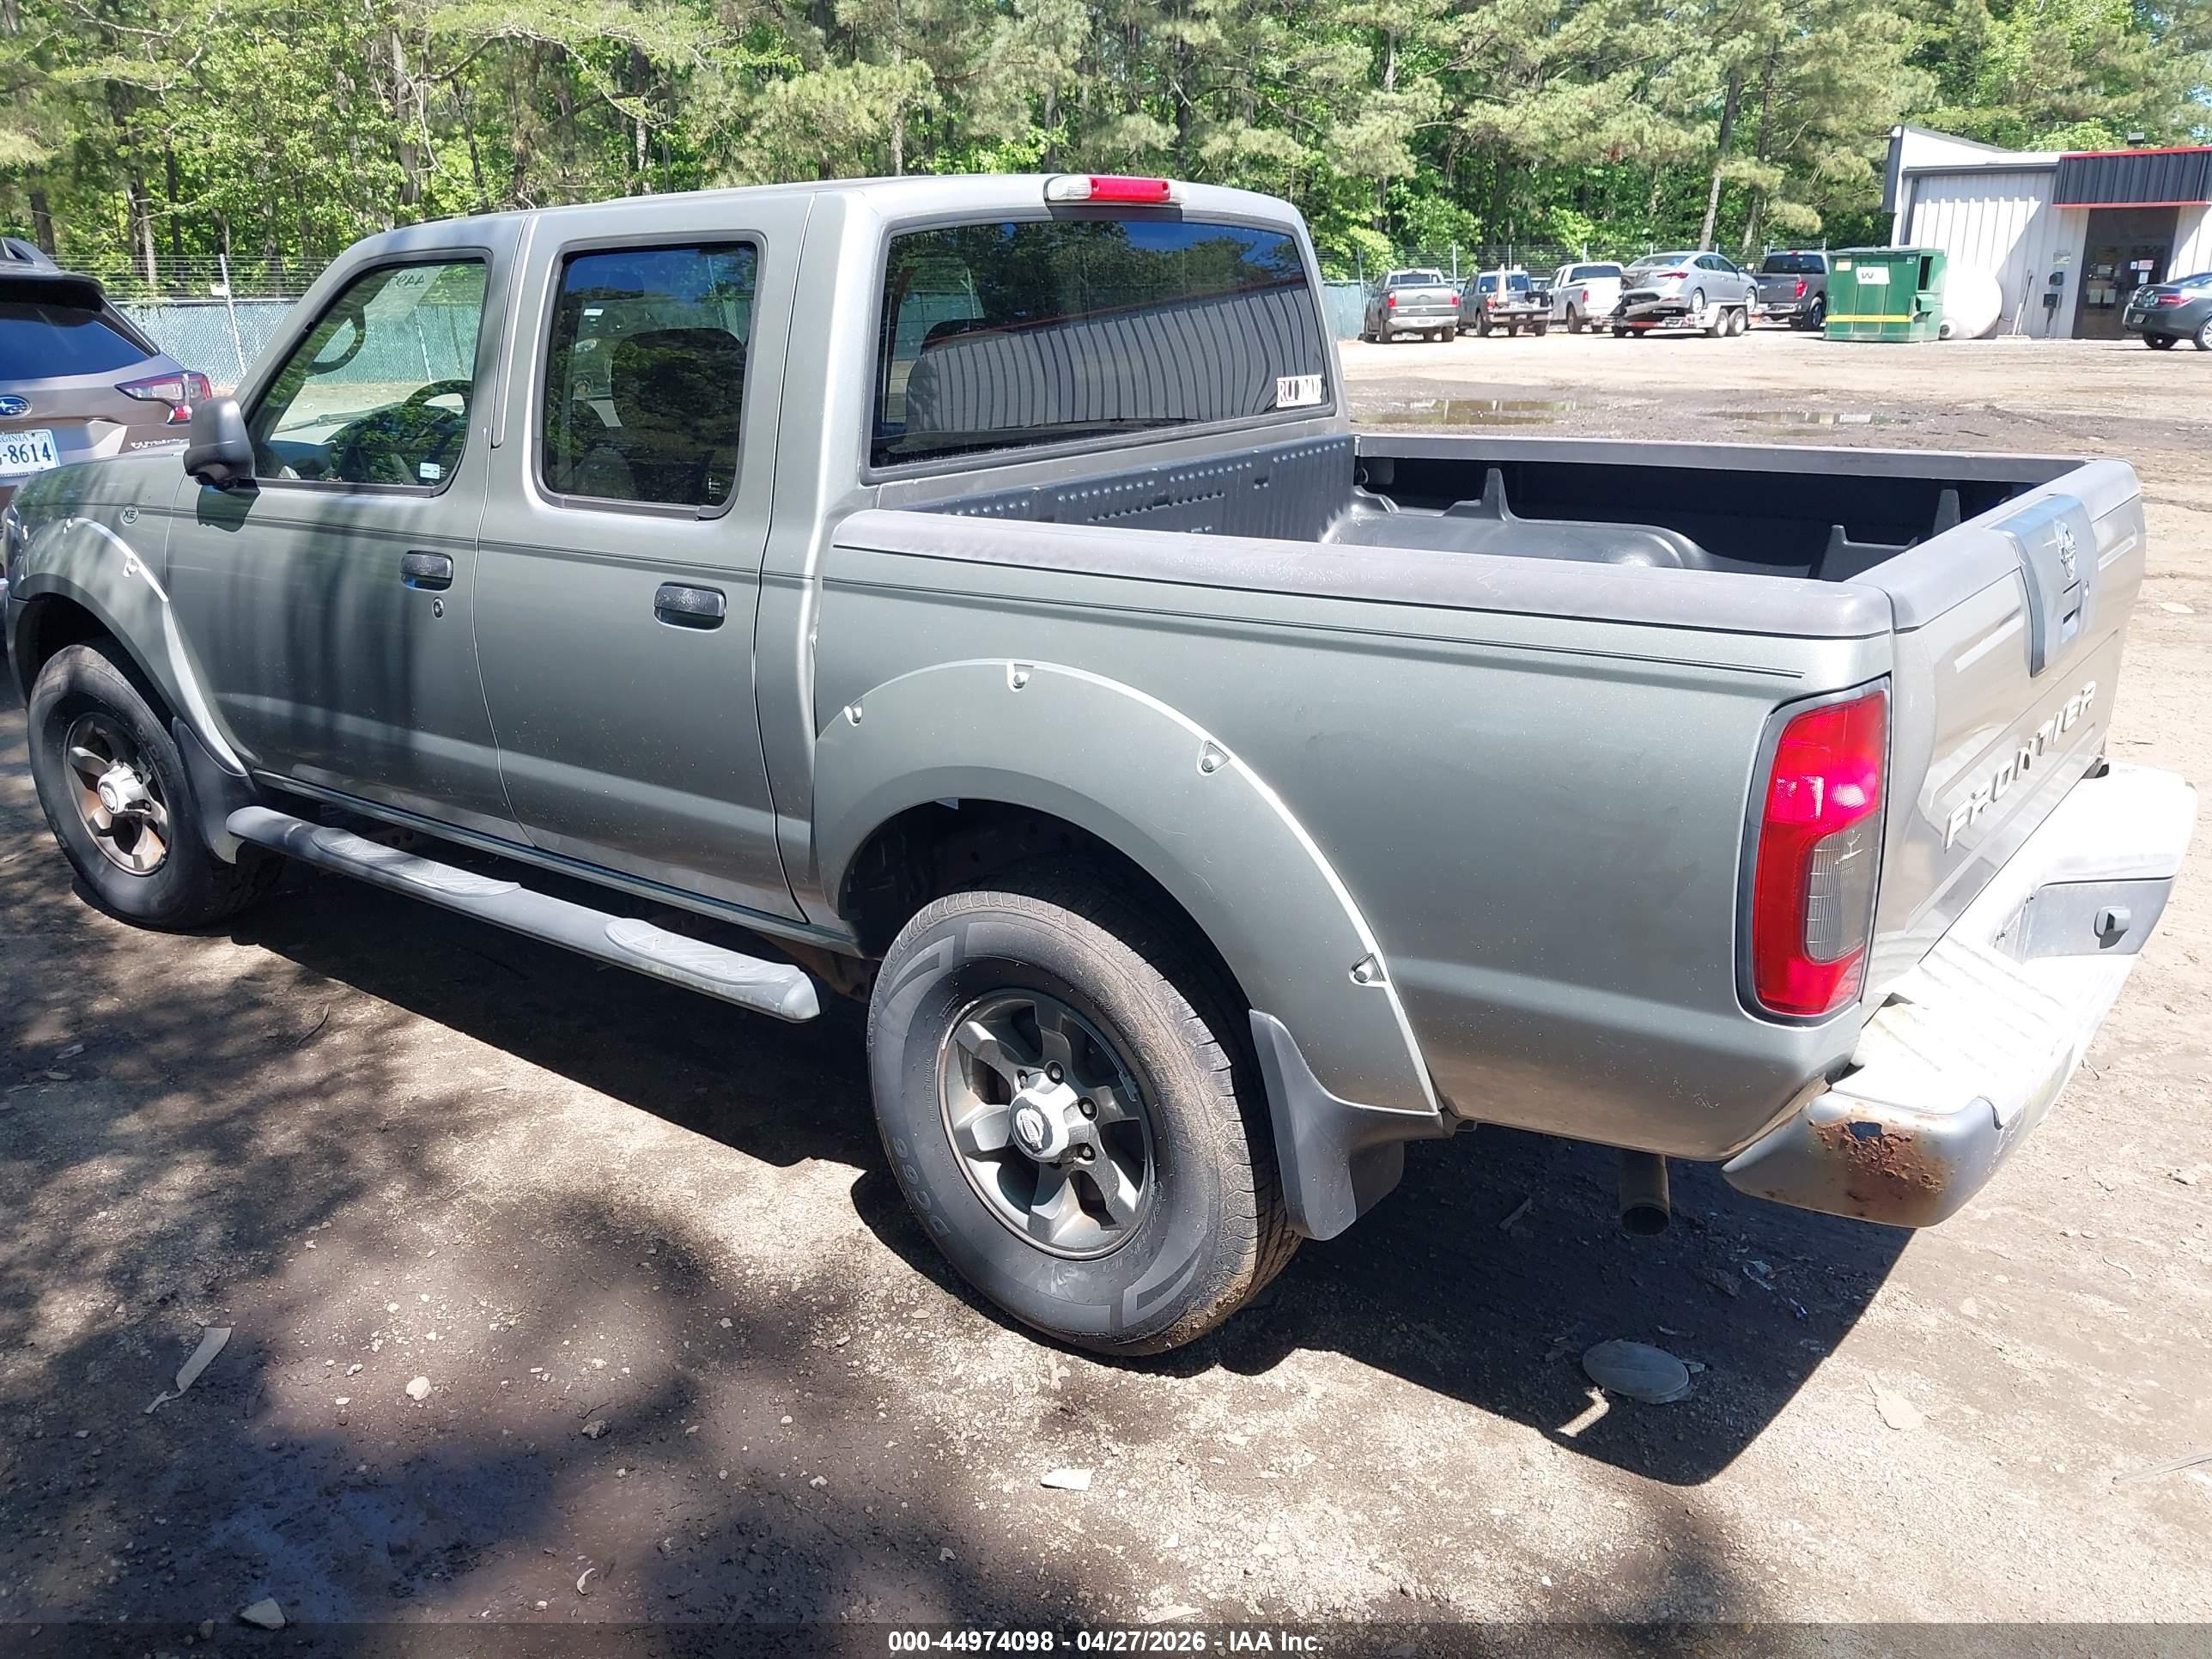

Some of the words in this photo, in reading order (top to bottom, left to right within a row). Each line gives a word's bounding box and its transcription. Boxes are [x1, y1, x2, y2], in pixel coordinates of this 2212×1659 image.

[0, 434, 29, 442] GINIA
[0, 442, 52, 465] -8614
[124, 509, 136, 519] XE
[1944, 681, 2097, 854] FRONTIER
